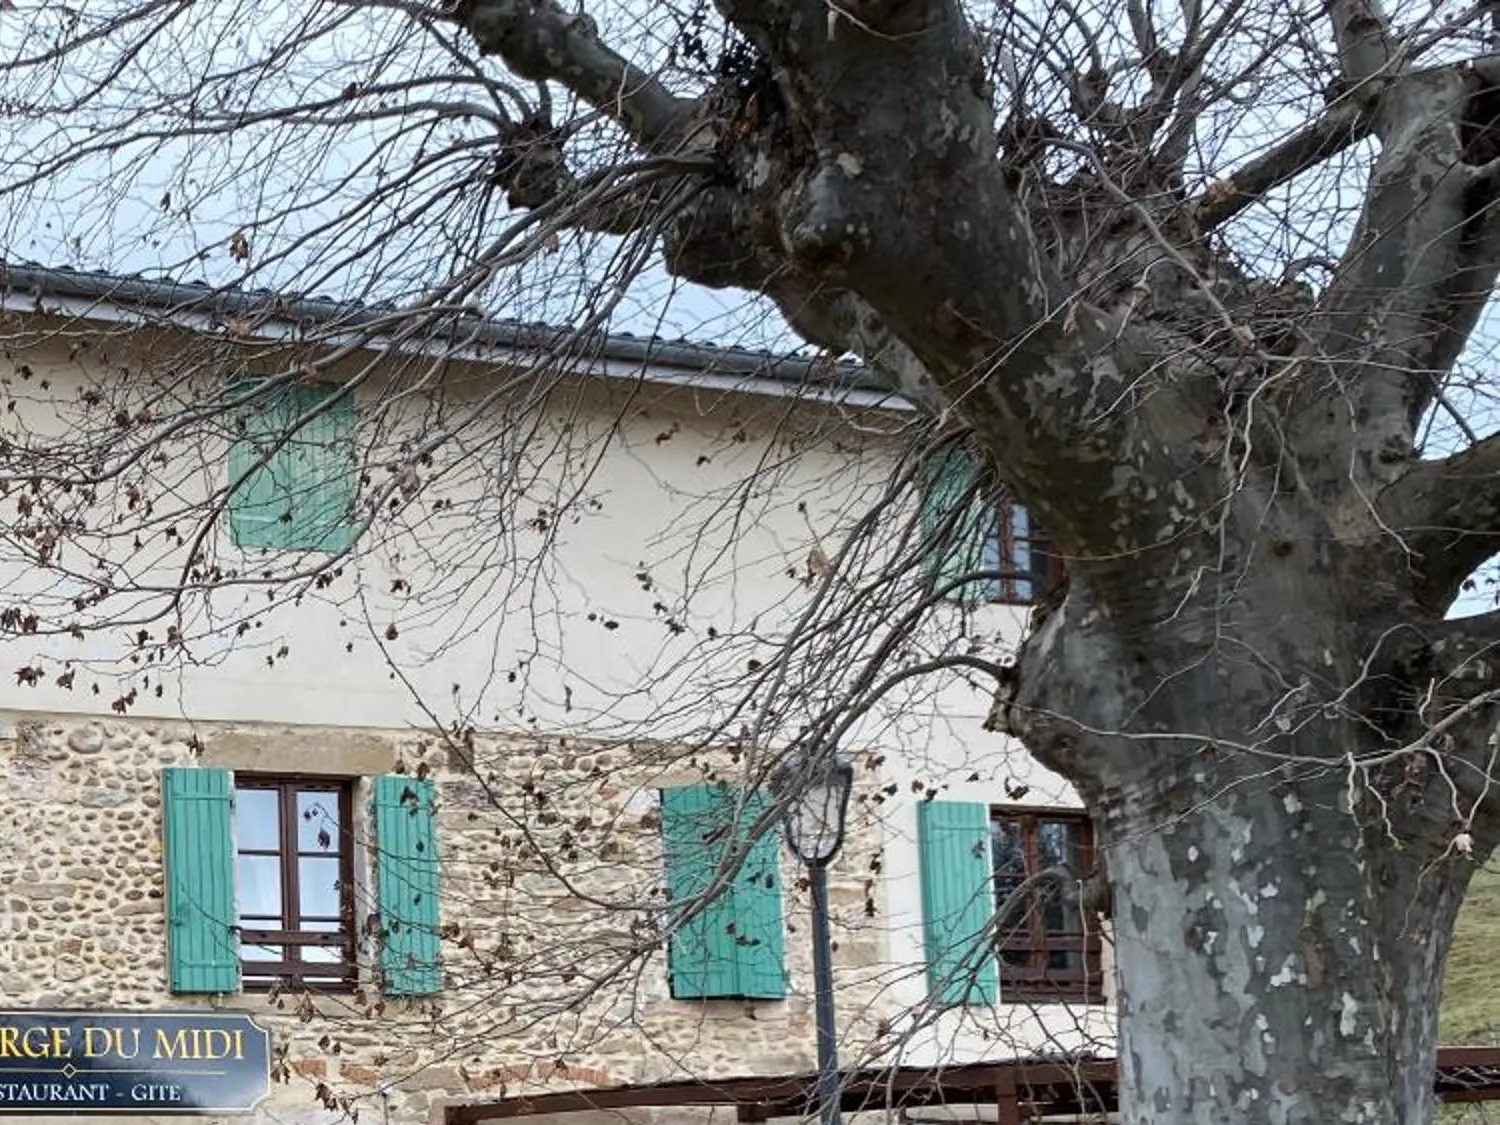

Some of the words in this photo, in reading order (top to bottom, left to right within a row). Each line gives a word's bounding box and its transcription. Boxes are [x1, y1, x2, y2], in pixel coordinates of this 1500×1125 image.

[84, 1026, 141, 1060] DU
[152, 1028, 245, 1061] MIDI
[131, 1083, 182, 1102] GITE
